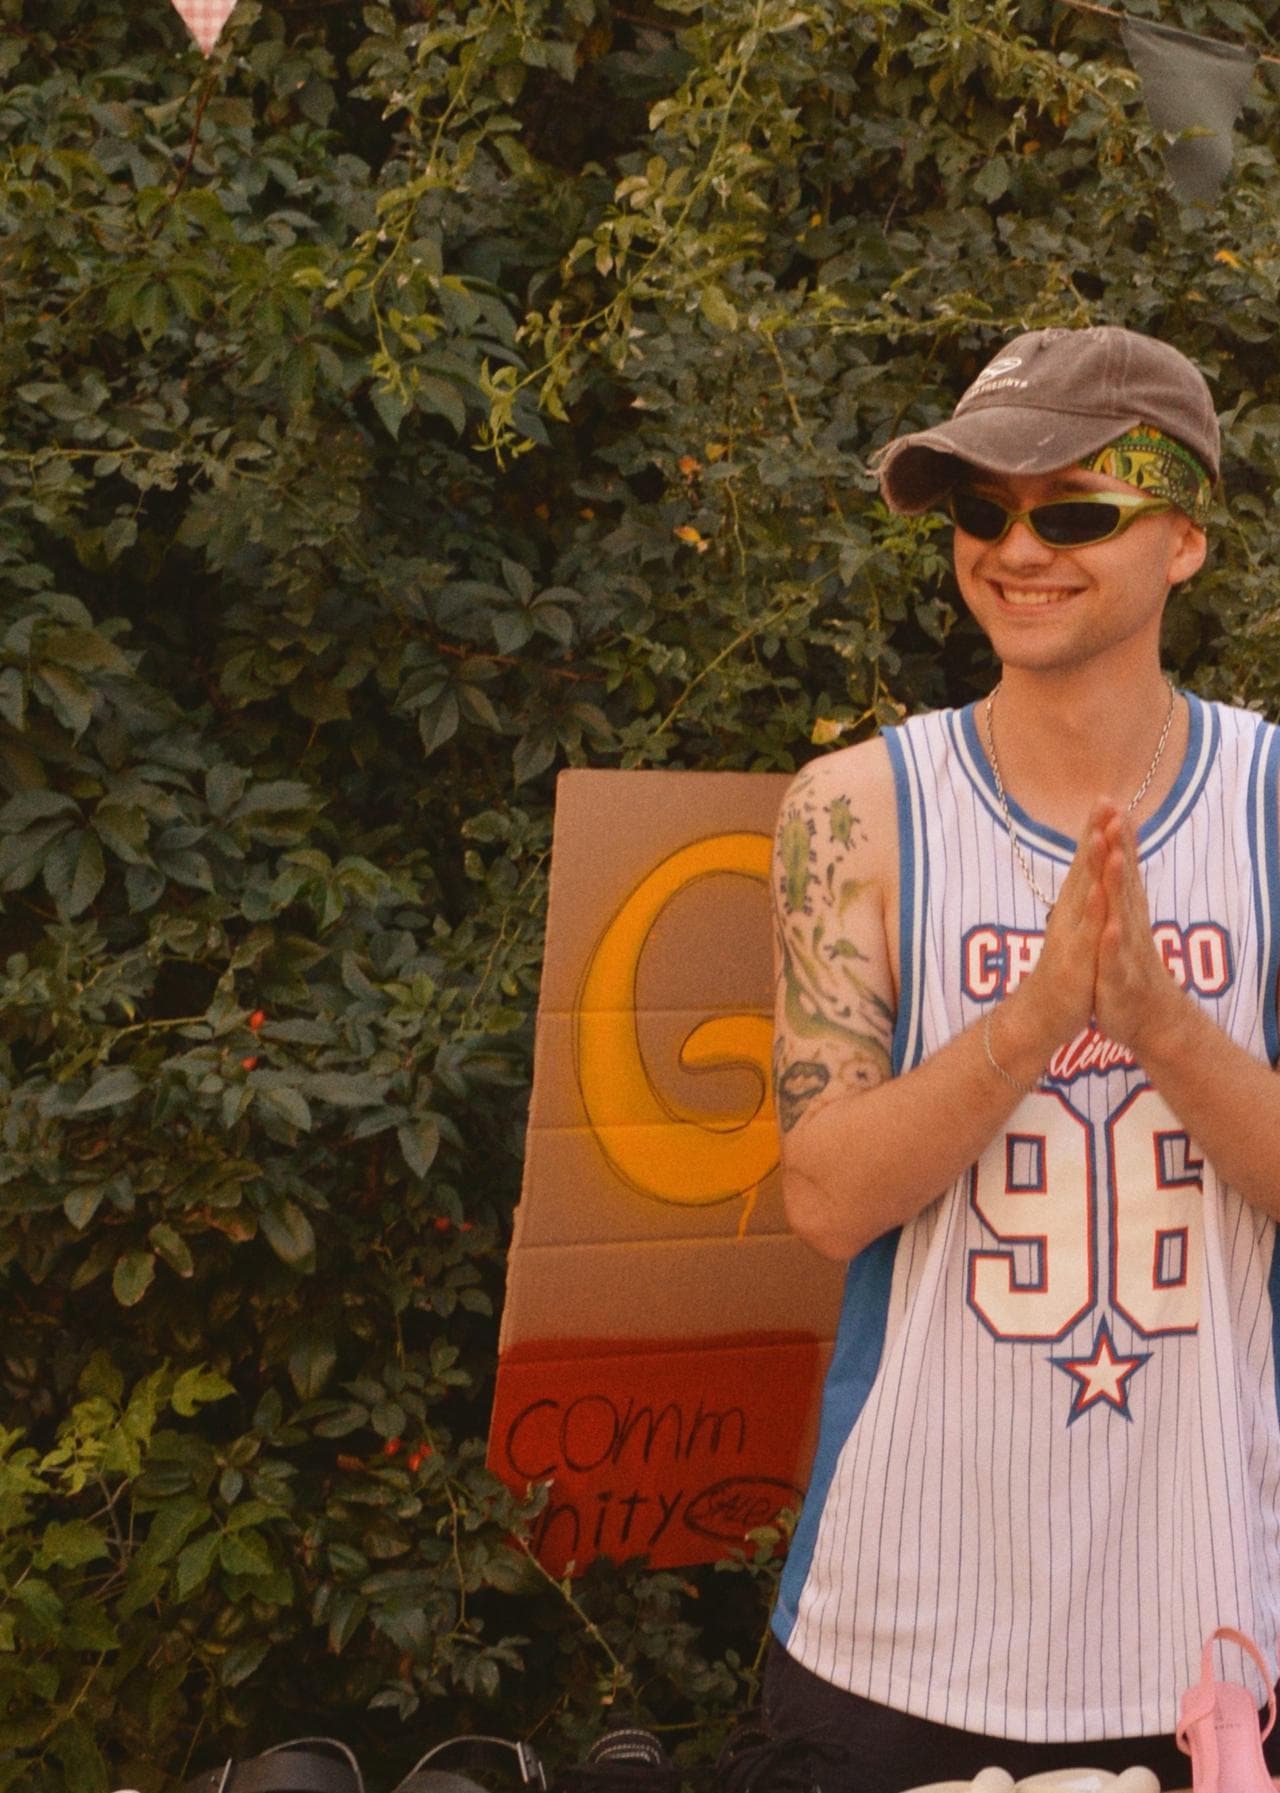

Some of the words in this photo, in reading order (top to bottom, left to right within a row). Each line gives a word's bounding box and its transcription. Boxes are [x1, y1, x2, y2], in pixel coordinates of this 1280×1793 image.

[961, 920, 1236, 1003] CHGO
[966, 1085, 1204, 1343] 96
[528, 1488, 685, 1554] nity
